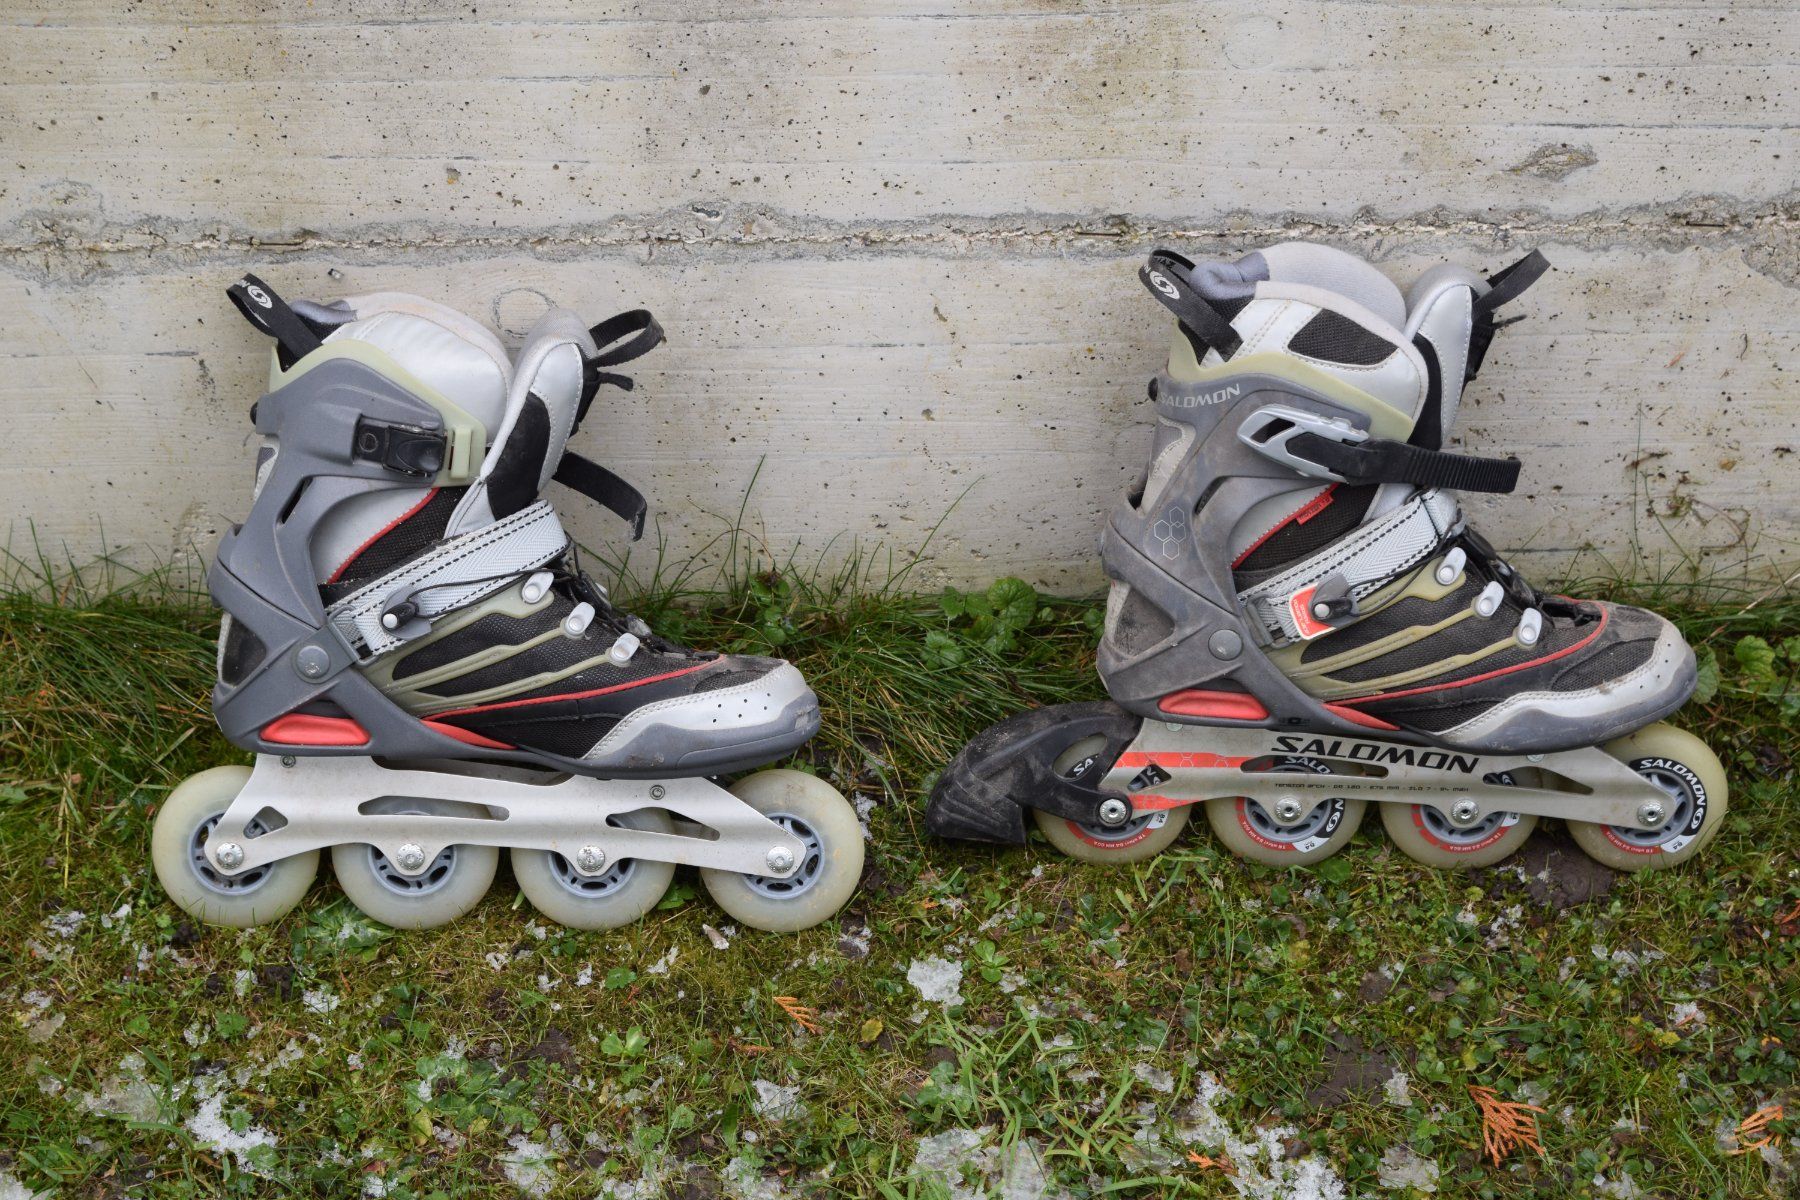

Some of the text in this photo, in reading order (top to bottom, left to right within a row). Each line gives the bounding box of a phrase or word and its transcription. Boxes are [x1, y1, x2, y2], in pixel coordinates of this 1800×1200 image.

[1160, 383, 1240, 408] SALOMON
[1271, 736, 1480, 774] SALOMON
[1640, 759, 1706, 806] SALOMON
